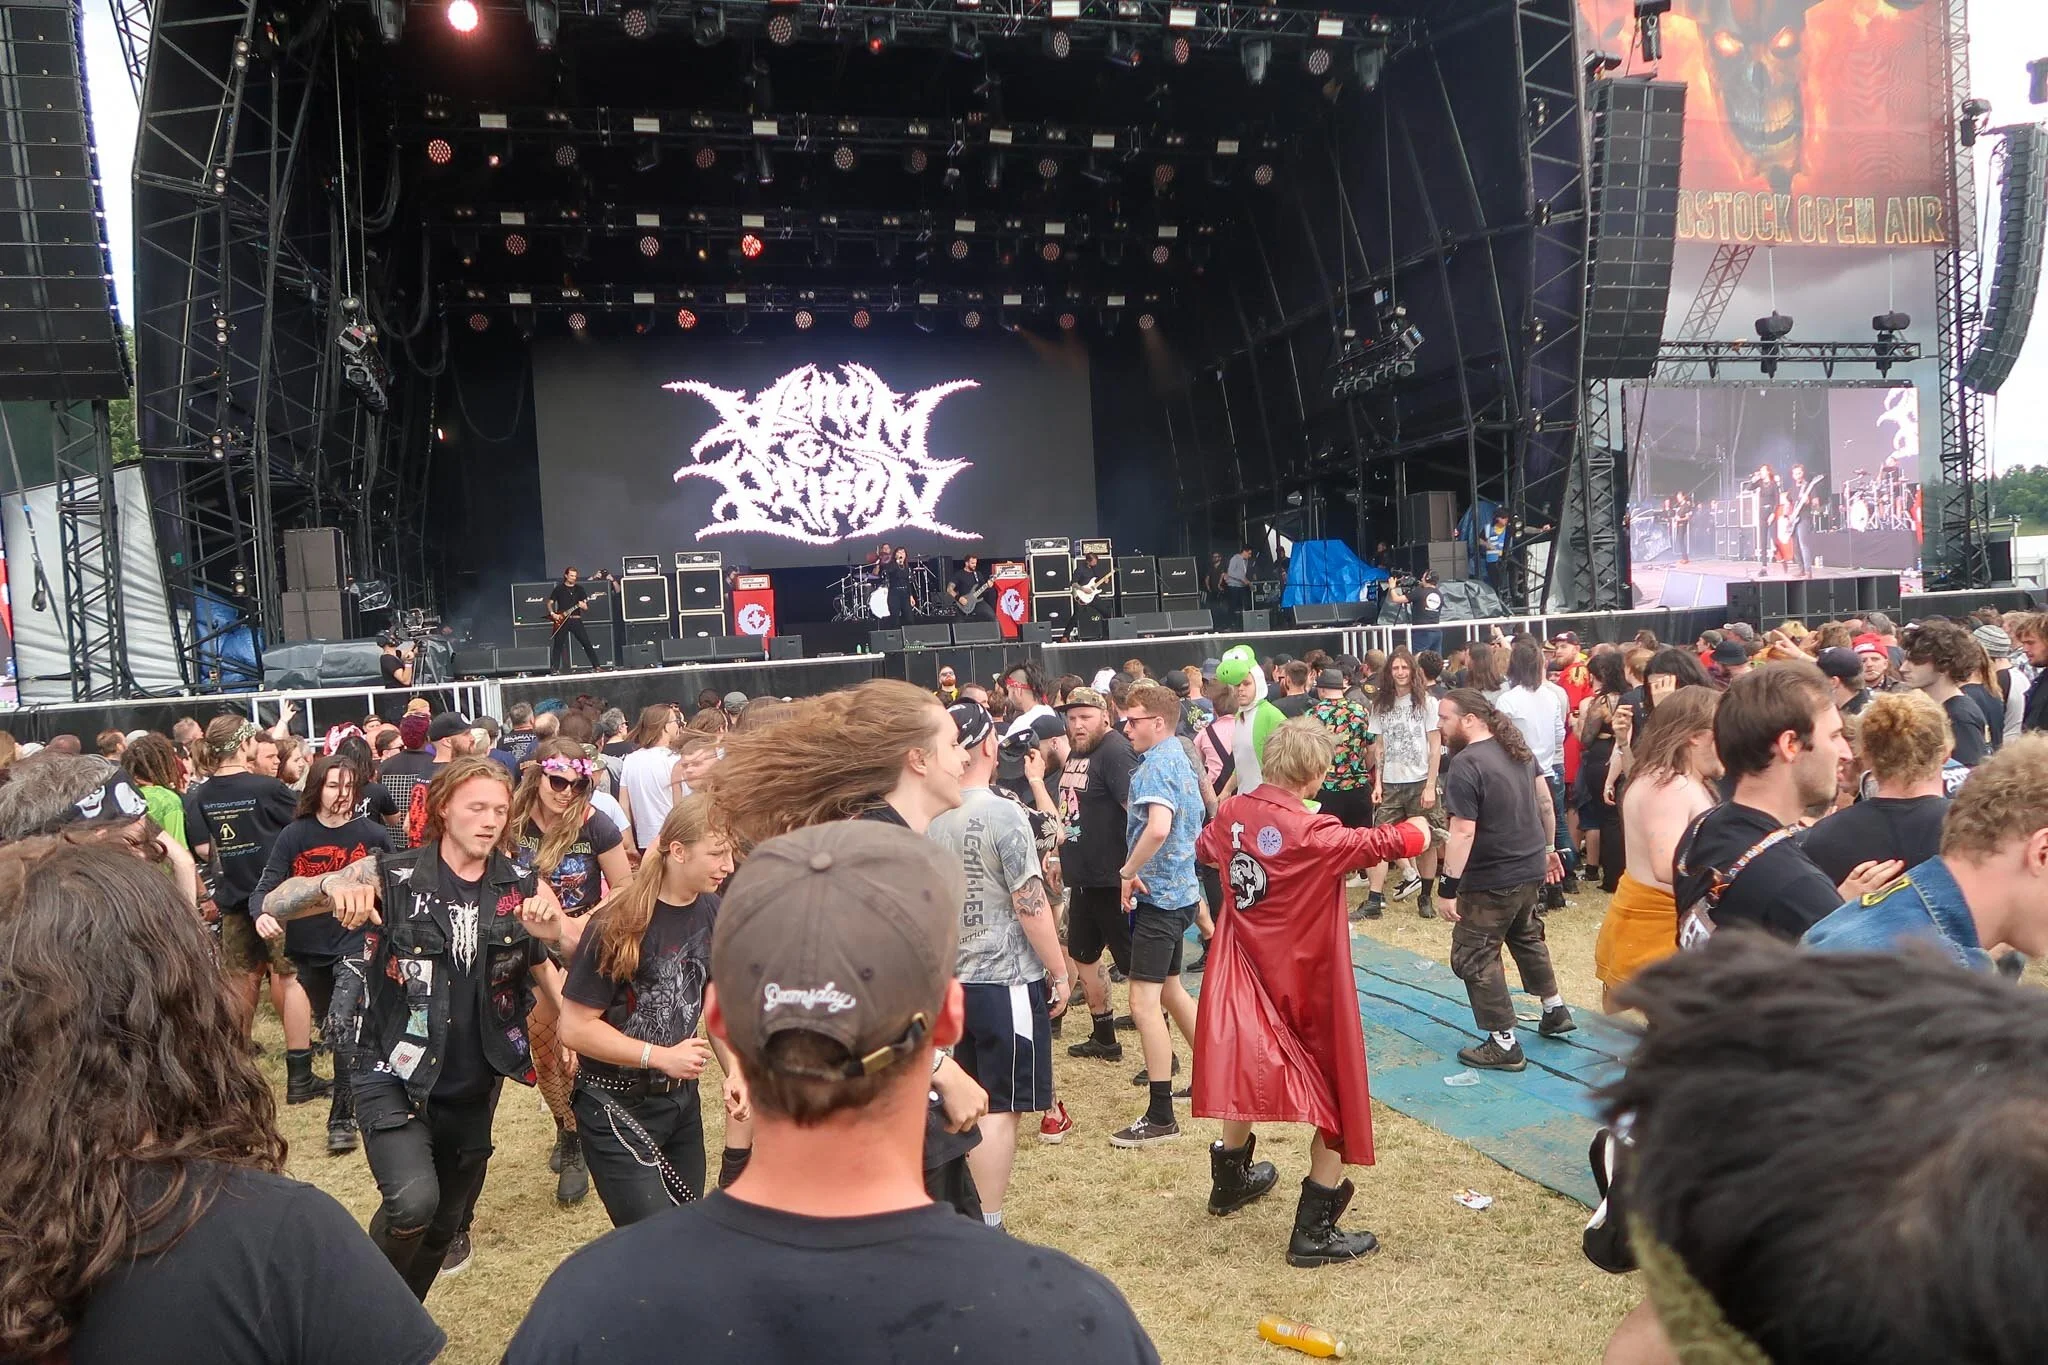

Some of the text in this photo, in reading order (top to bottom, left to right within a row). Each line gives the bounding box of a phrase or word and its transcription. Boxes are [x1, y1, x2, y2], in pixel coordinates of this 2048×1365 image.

[1678, 188, 1946, 244] DSTOCK OPEN AIR
[963, 818, 985, 927] ACHILLES
[959, 927, 989, 945] arrior
